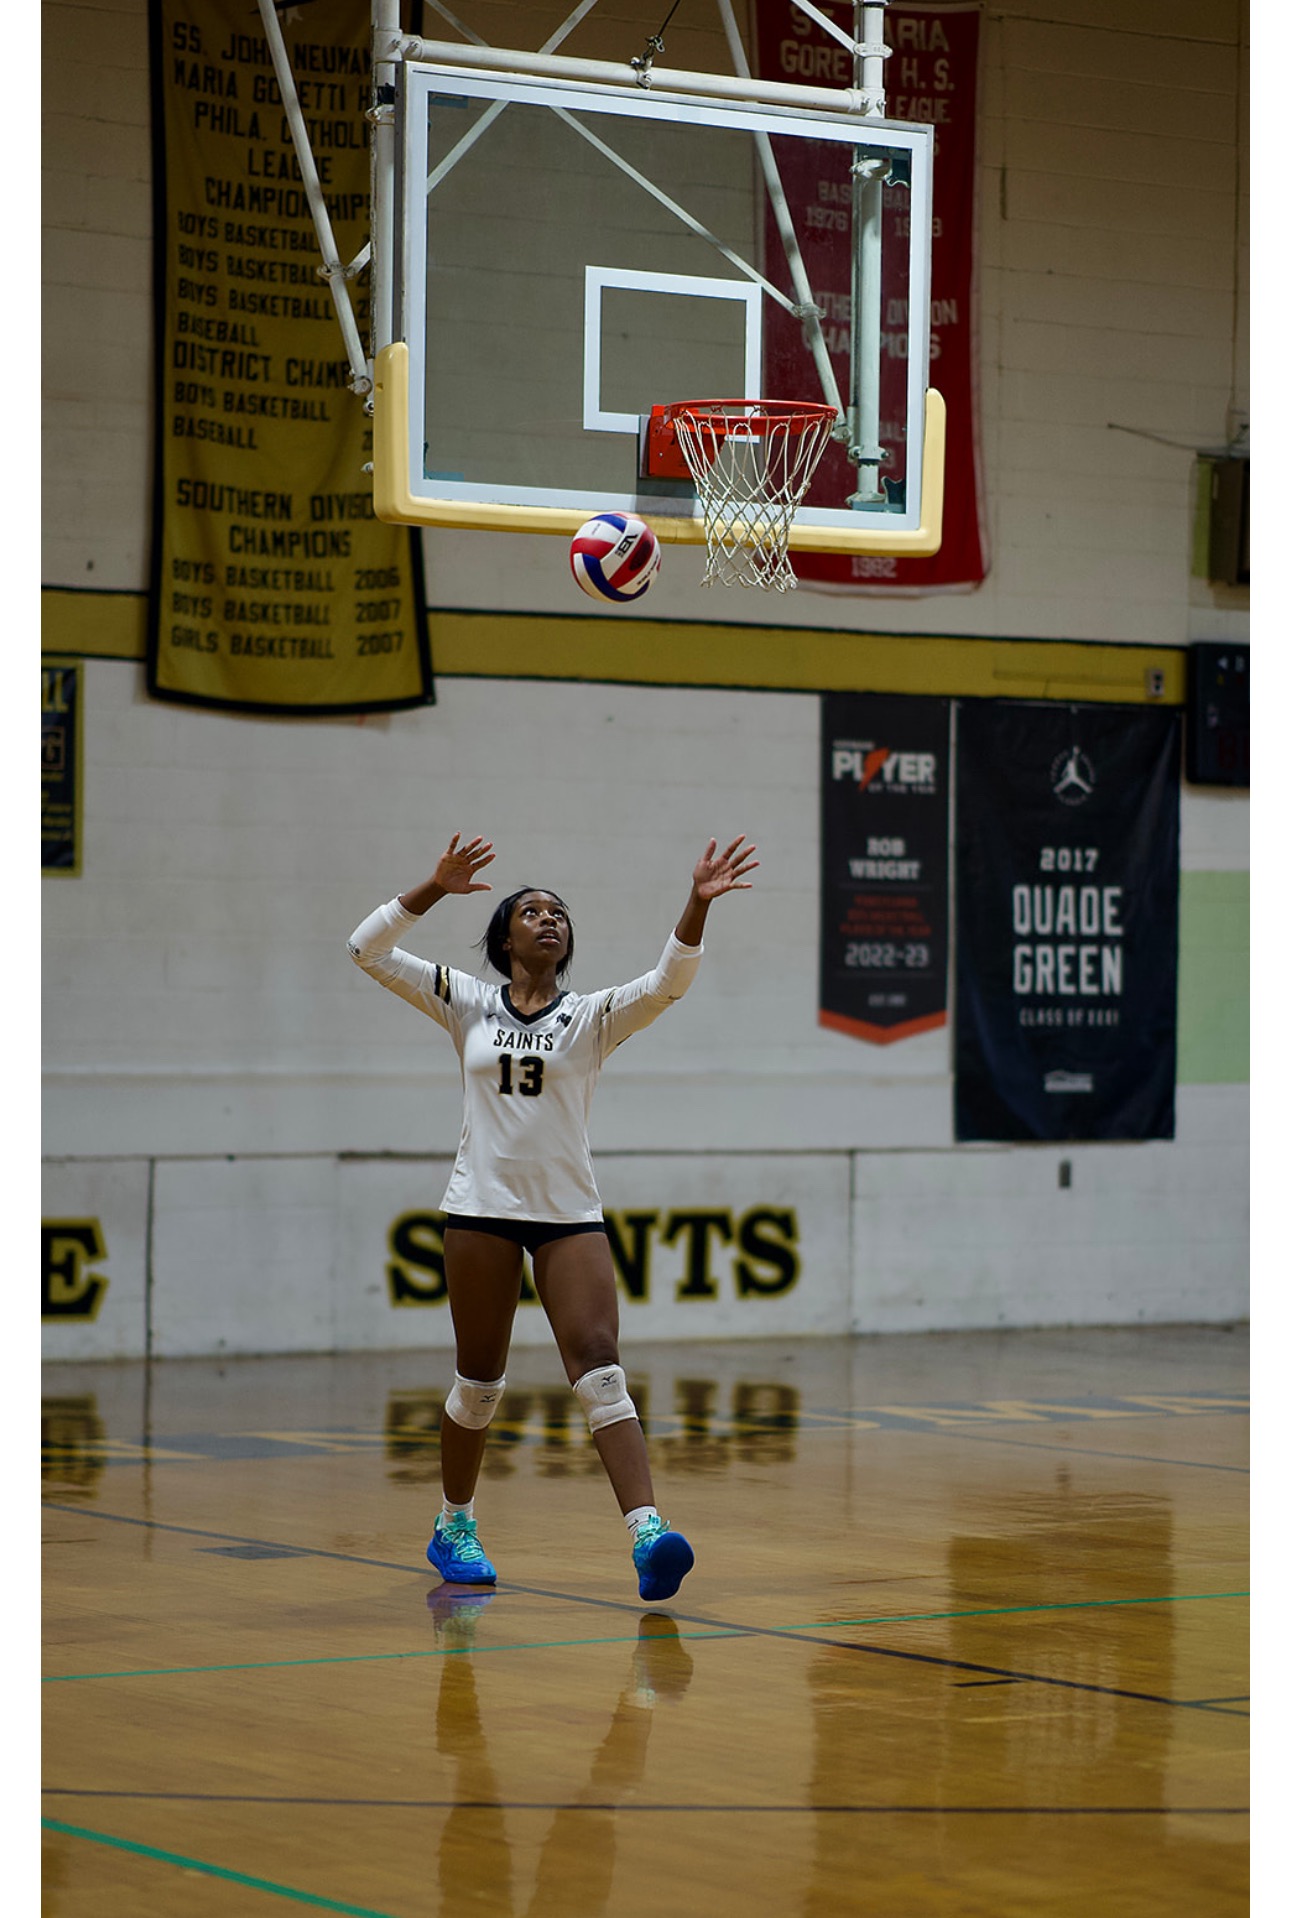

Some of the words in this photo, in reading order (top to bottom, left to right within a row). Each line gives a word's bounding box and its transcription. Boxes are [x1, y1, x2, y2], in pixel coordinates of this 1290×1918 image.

[221, 33, 274, 66] JOH
[294, 43, 371, 76] NEUMAN
[174, 59, 238, 99] MARIA
[253, 75, 346, 113] GOETTI
[194, 101, 268, 142] PHILA.
[281, 116, 371, 149] CTHOLI
[248, 147, 333, 185] LEAGE
[205, 177, 371, 222] CHAMPIONHIP
[224, 222, 320, 254] BASKETBAL
[228, 289, 333, 321] BASKETBALL
[177, 312, 260, 347] BASEBALL
[174, 340, 271, 383] DISTRICT
[286, 358, 351, 389] CHAMP
[223, 391, 330, 422] BASKETBALL
[173, 415, 257, 450] BASEBALL
[176, 478, 292, 521] SOUTHERN
[229, 525, 352, 559] CHAMPIONS
[172, 558, 215, 585] BOYS
[226, 566, 335, 592] BASKETBALL
[172, 592, 212, 619] BOYS
[224, 600, 330, 626] BASKETBALL
[355, 599, 400, 624] 2007
[171, 626, 218, 653] GIRLS
[230, 634, 335, 659] BASKETBALL
[356, 631, 404, 656] 2007
[849, 859, 921, 880] WRIGHT
[1040, 848, 1098, 871] 2017
[845, 943, 930, 968] 2022-23
[1013, 944, 1123, 996] GREEN
[493, 1029, 554, 1052] SAINTS
[498, 1053, 545, 1097] 13
[387, 1204, 802, 1307] SNTS
